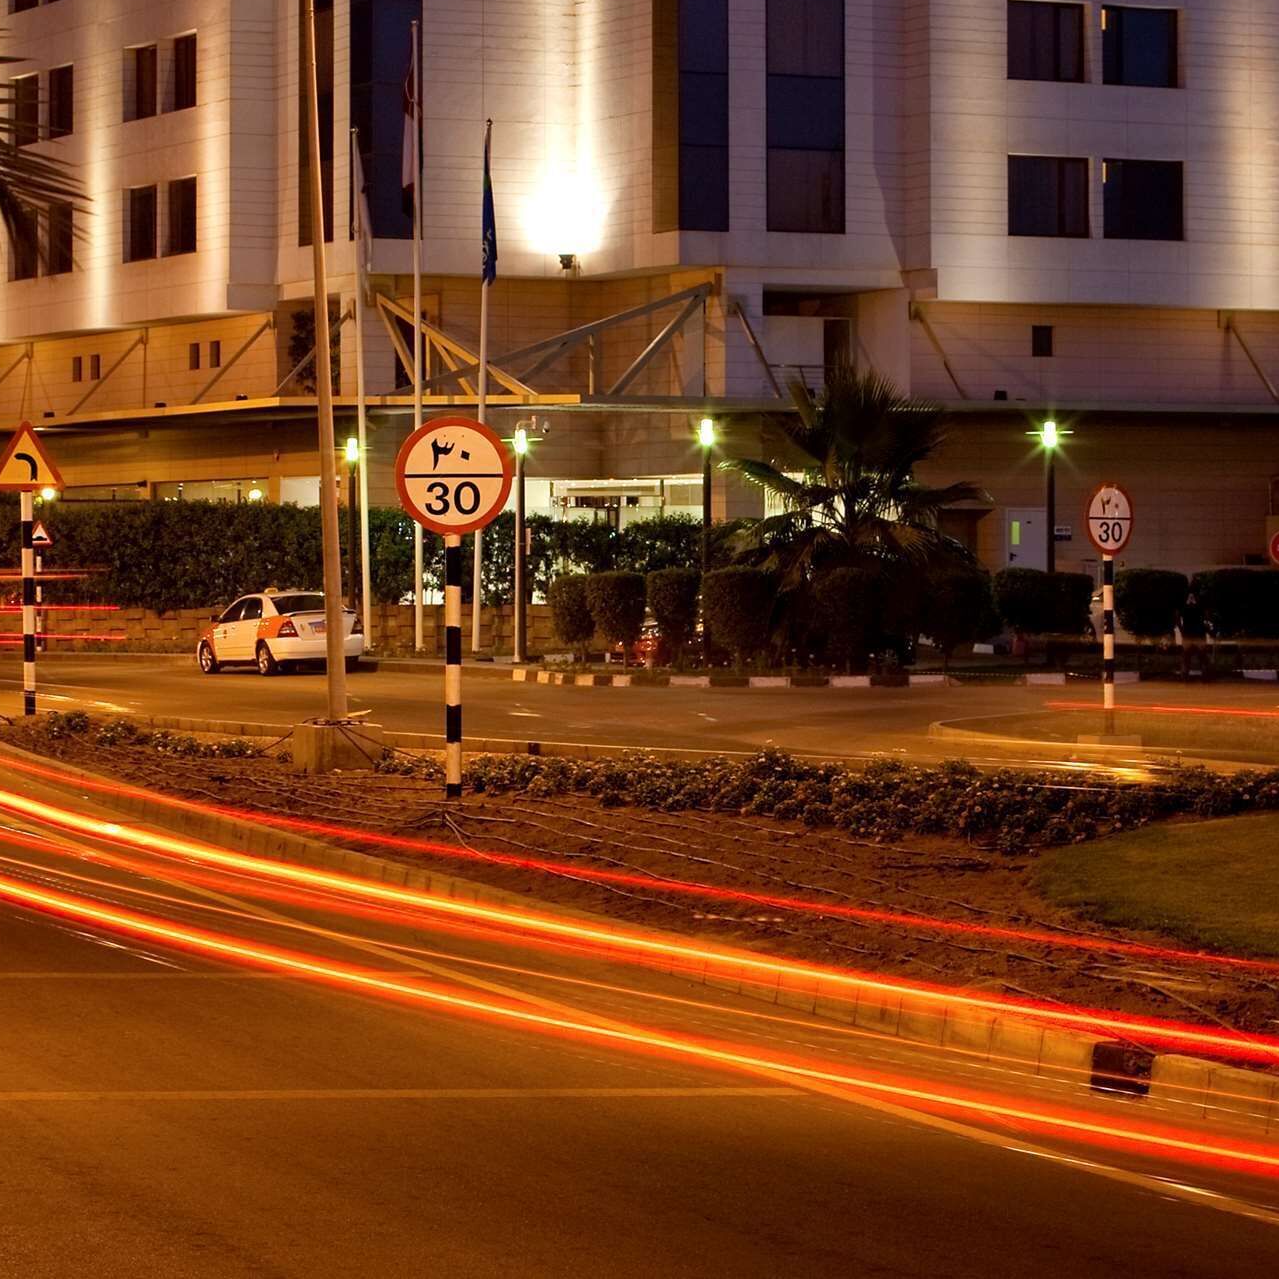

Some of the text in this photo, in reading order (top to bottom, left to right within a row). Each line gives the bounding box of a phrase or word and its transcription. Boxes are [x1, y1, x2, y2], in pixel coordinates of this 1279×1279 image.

[431, 438, 471, 471] ٣٠
[425, 481, 481, 516] 30
[1099, 522, 1122, 543] 30
